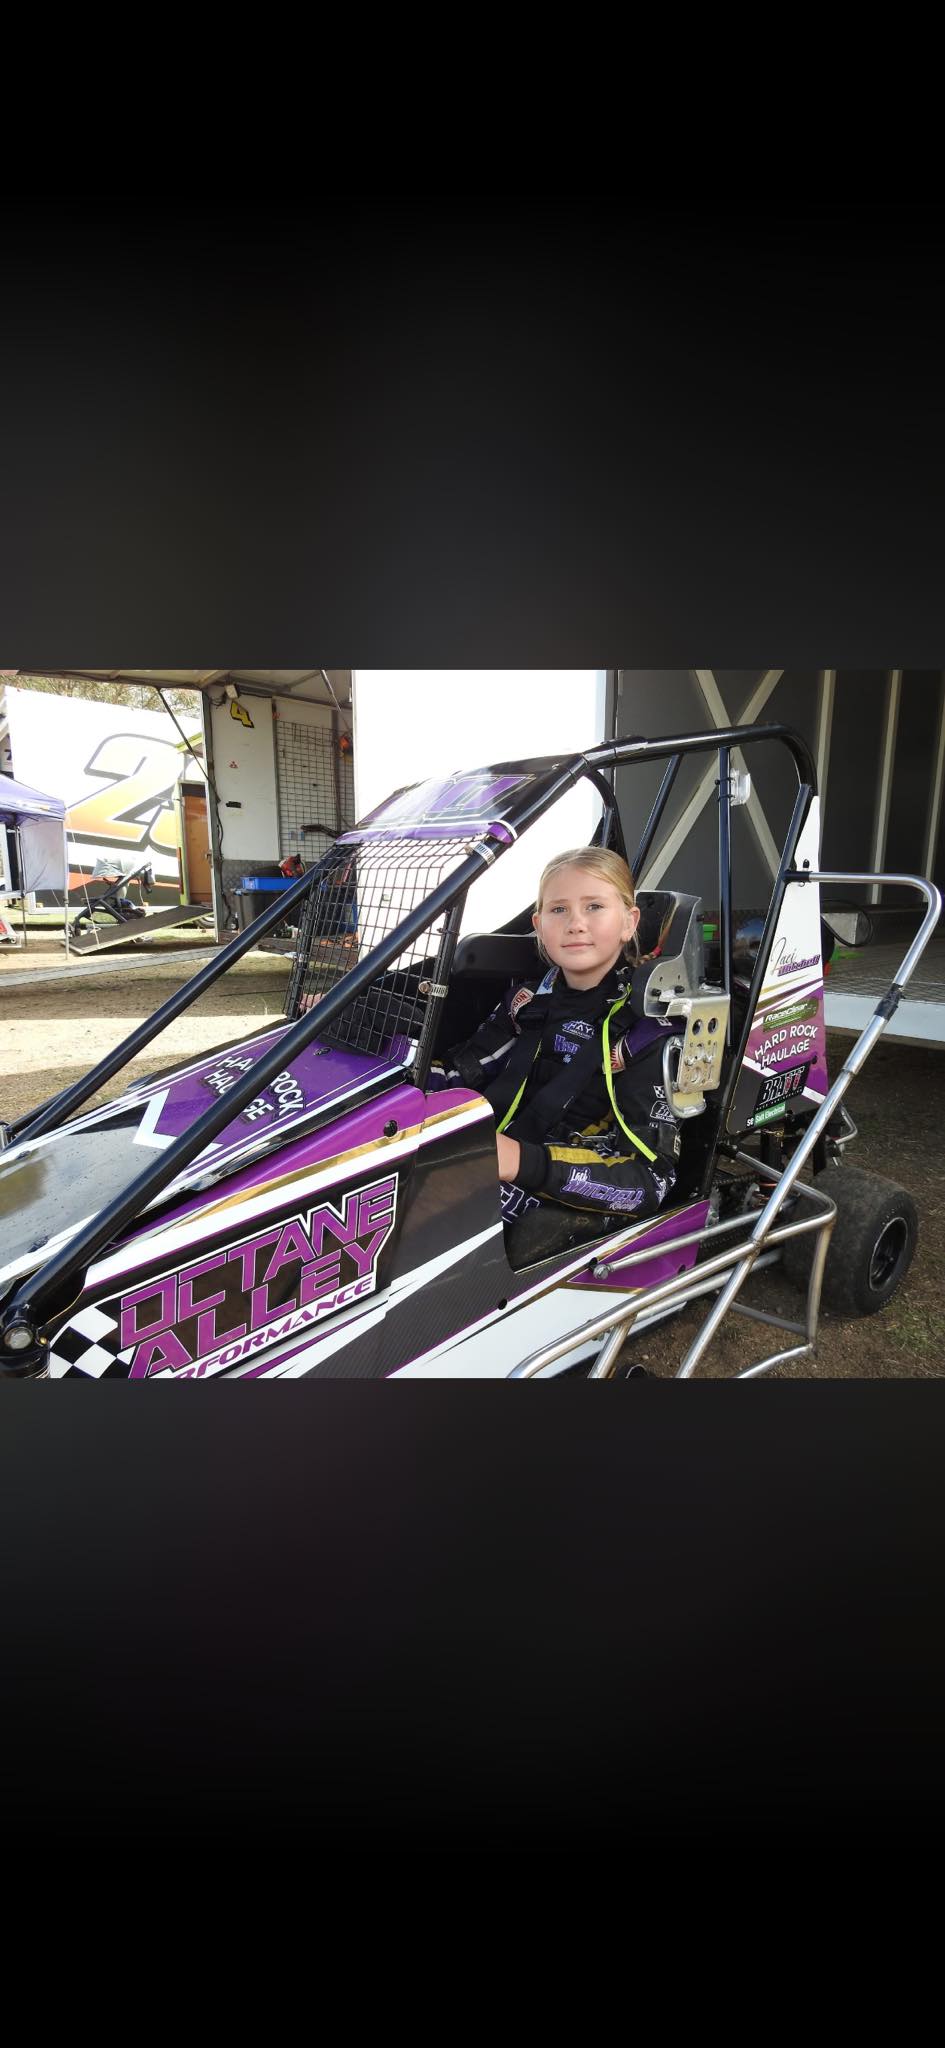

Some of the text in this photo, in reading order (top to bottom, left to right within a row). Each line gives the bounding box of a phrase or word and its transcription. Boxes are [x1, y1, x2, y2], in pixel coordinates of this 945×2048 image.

[230, 700, 254, 728] 4
[755, 1024, 818, 1060] HARD ROCK
[761, 1039, 810, 1068] HAULAGE
[562, 1180, 643, 1205] MITCHELL
[120, 1179, 394, 1350] OCTANE
[128, 1227, 388, 1379] ALLEY
